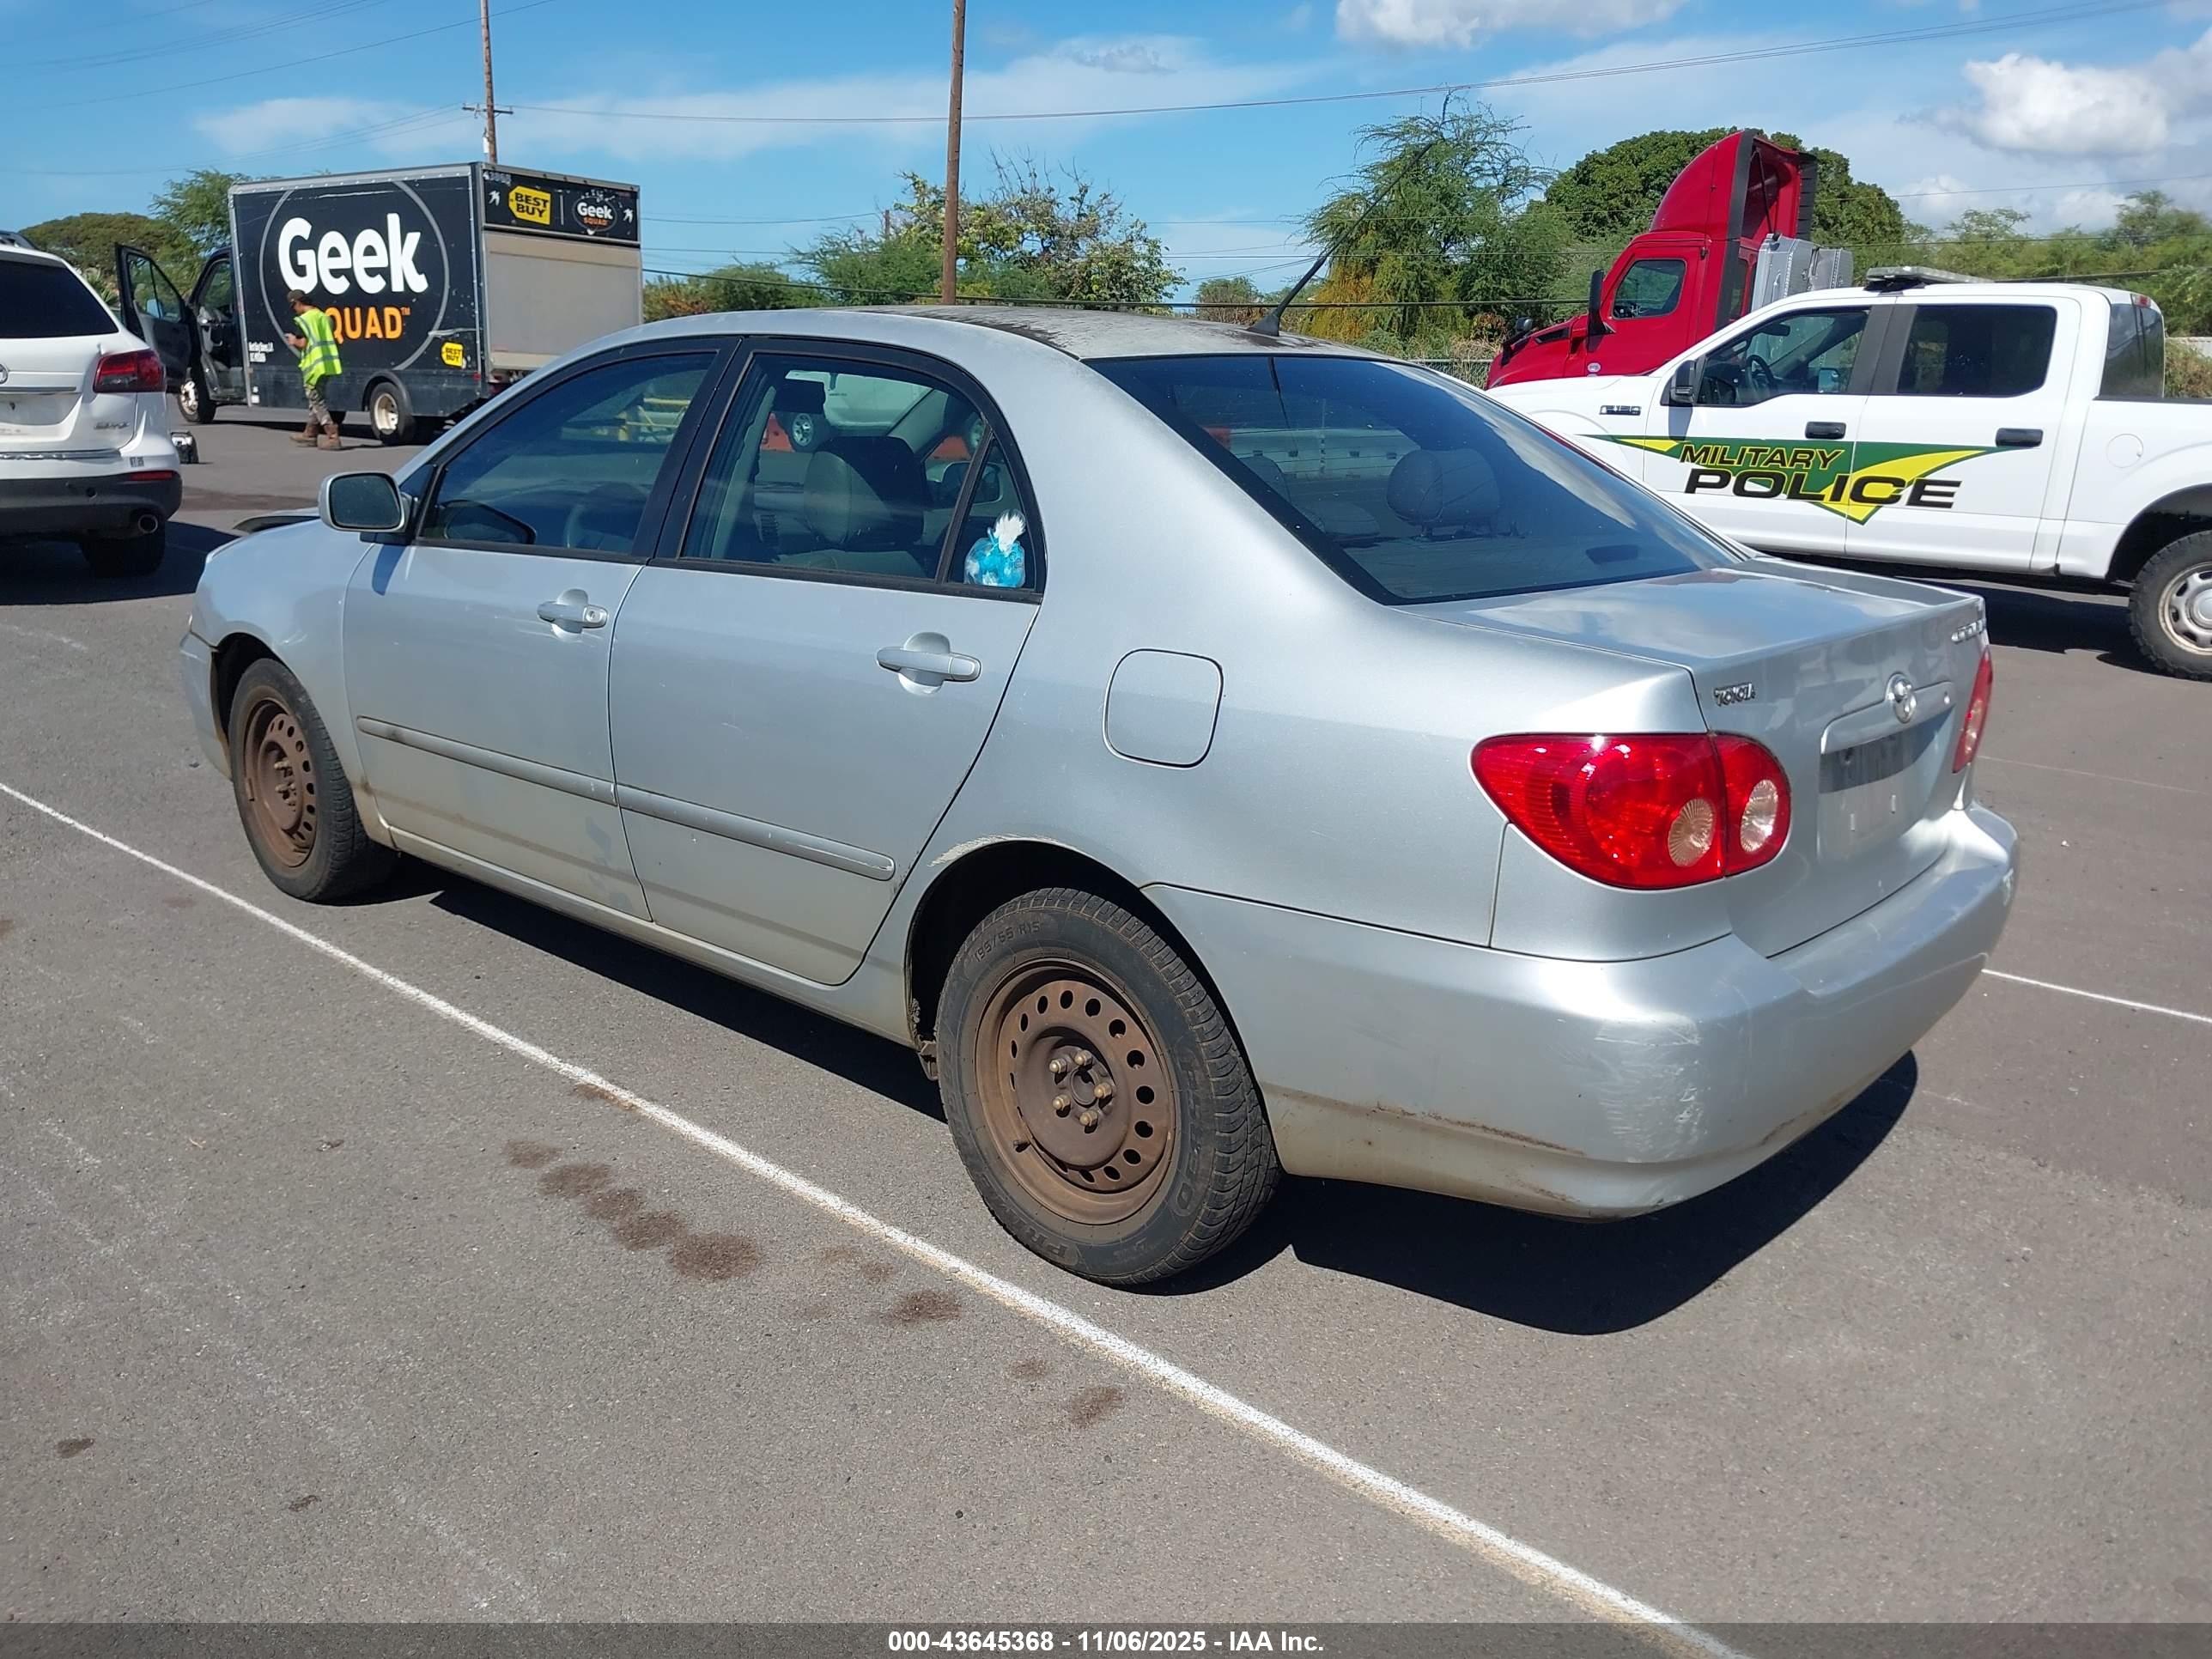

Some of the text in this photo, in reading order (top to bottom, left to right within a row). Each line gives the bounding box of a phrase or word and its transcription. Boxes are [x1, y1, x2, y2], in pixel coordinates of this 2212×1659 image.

[515, 193, 550, 209] BEST
[516, 204, 546, 218] BUY
[577, 202, 613, 220] Geek
[278, 213, 428, 295] Geek
[324, 306, 402, 344] QUAD
[1680, 445, 1844, 469] MILITARY
[1685, 468, 1962, 509] POLICE
